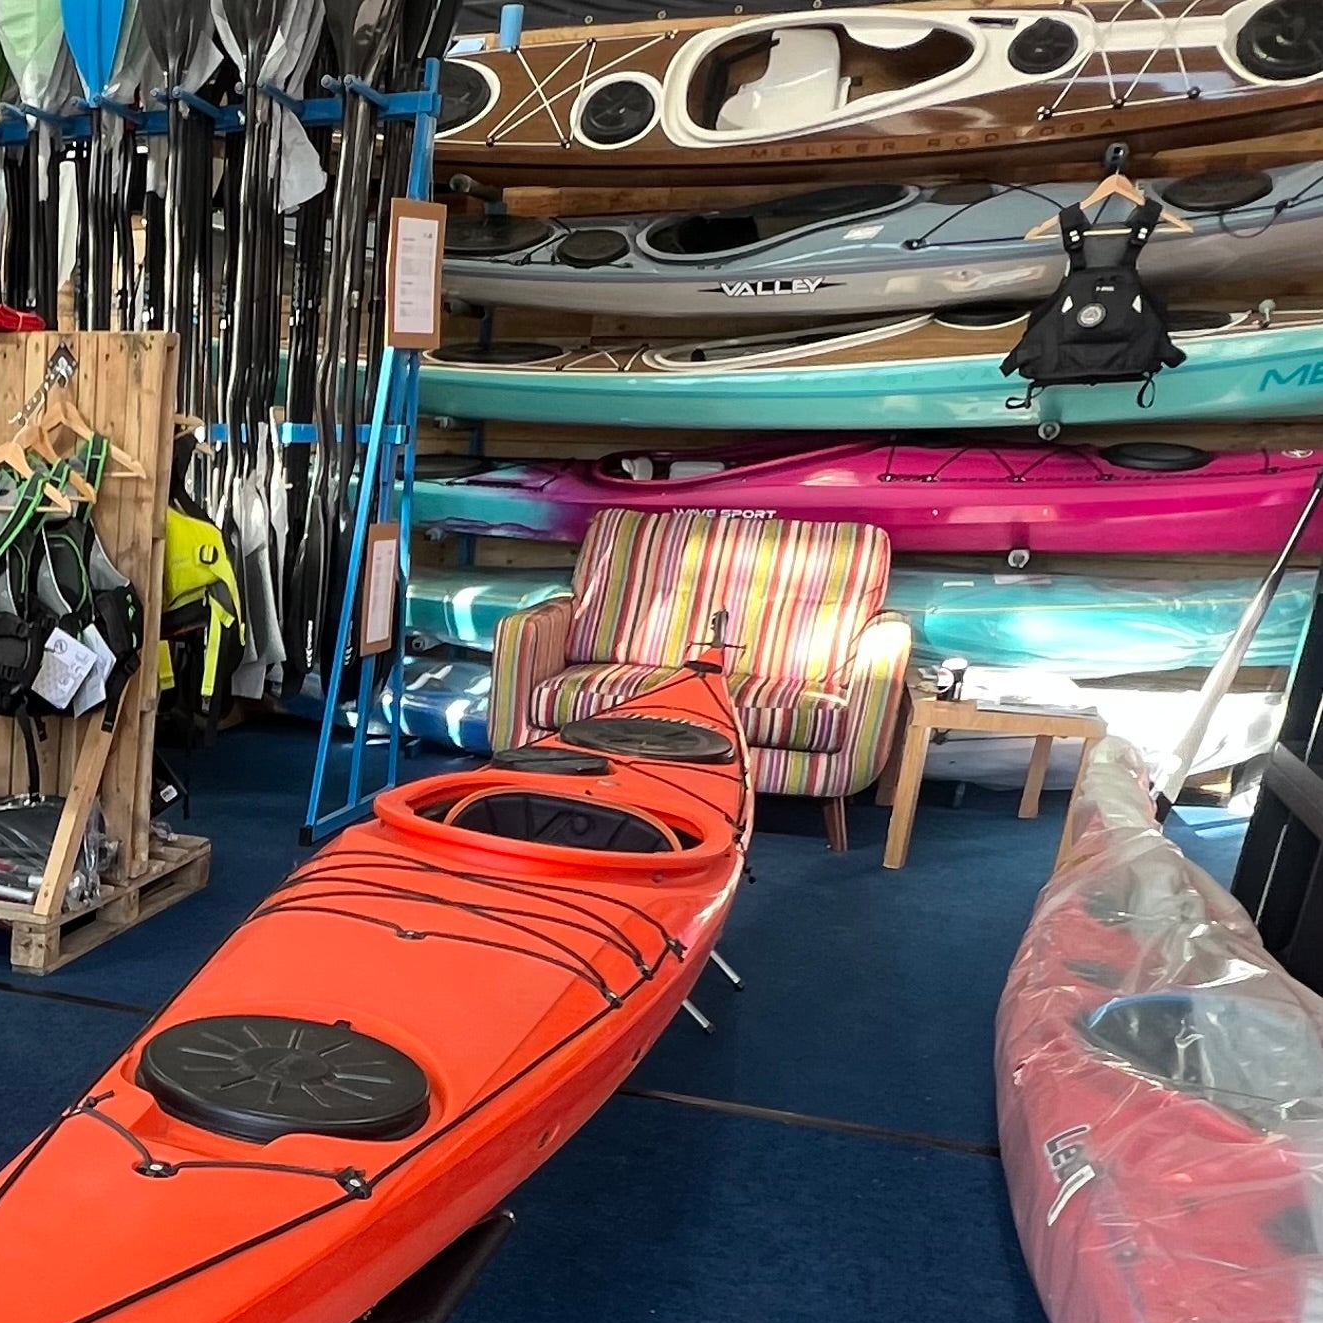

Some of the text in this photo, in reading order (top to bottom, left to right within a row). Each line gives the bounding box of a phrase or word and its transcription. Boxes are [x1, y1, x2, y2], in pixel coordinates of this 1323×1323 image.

[750, 142, 896, 158] MELKER
[720, 277, 824, 297] VALLEY
[720, 508, 777, 519] SPORT
